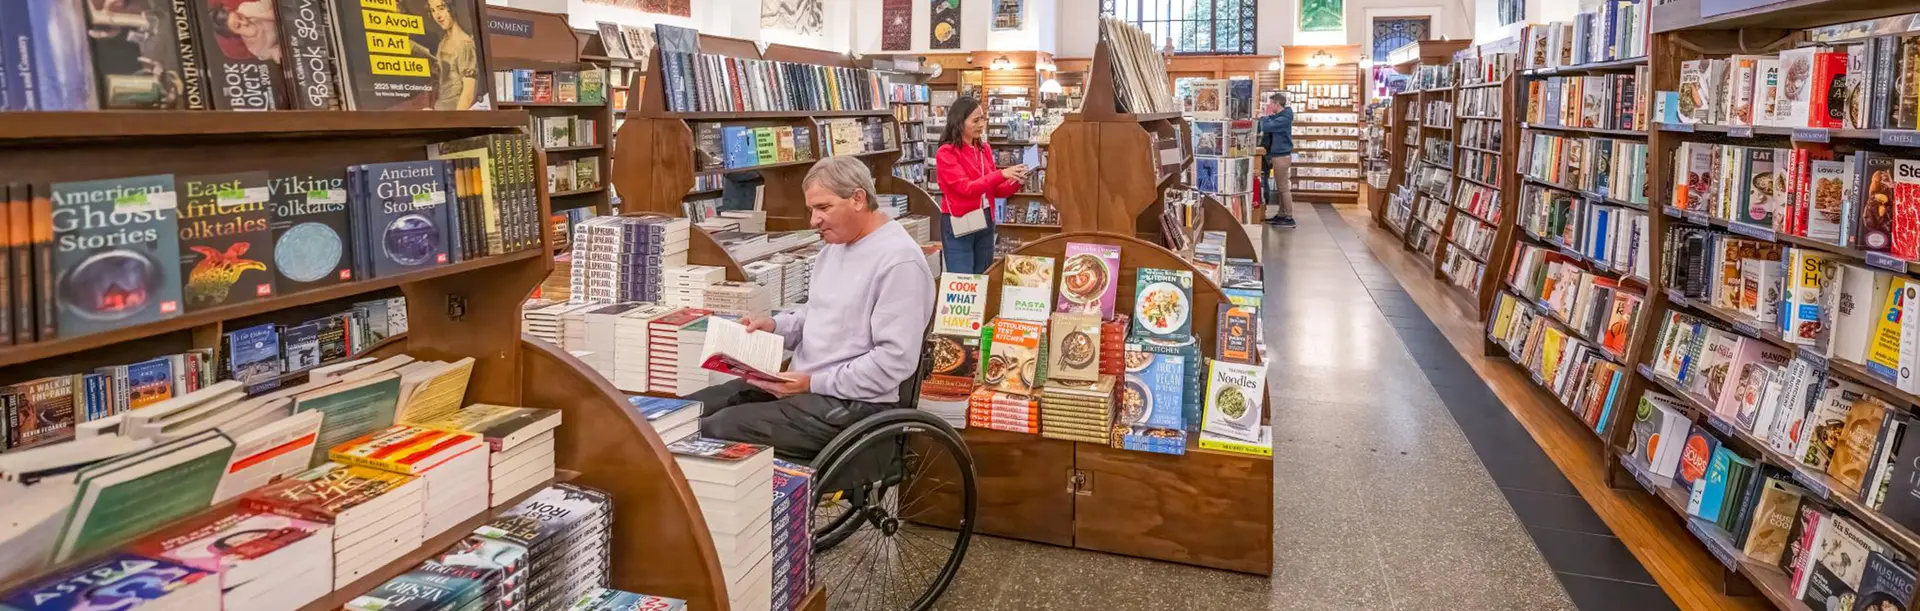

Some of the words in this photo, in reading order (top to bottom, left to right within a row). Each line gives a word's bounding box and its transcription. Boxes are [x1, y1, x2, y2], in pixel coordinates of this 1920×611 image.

[368, 13, 382, 25] to
[385, 15, 419, 29] Avoid
[372, 36, 384, 48] in
[387, 38, 405, 49] Art
[376, 61, 401, 72] and
[403, 62, 424, 73] Life
[181, 43, 202, 109] JONATHAN
[303, 46, 328, 107] Book
[223, 63, 242, 107] BOOK
[374, 82, 389, 90] 2025
[390, 83, 404, 91] Wall
[404, 84, 433, 92] Calendar
[1753, 151, 1770, 160] EAT
[379, 166, 434, 180] Ancient
[186, 179, 242, 198] East
[267, 176, 344, 196] Viking
[377, 179, 439, 199] Ghost
[51, 185, 164, 206] American
[384, 200, 436, 214] Stories
[52, 206, 167, 232] Ghost
[180, 216, 268, 240] olktales
[59, 227, 158, 253] Stories
[949, 281, 977, 292] COOK
[946, 293, 977, 304] WHAT
[1015, 300, 1045, 309] PASTA
[950, 304, 971, 316] YOU
[942, 315, 971, 328] HAVE
[997, 321, 1039, 333] OTTOLENGHI
[995, 333, 1025, 343] KITCHEN
[997, 327, 1014, 335] TEST
[1150, 345, 1180, 354] KITCHEN
[36, 379, 60, 394] WALK
[1155, 373, 1181, 386] VEGAN
[1217, 371, 1257, 389] Noodles
[49, 387, 72, 401] PARK
[1783, 375, 1797, 408] BUTCHERY
[1789, 378, 1803, 410] BUTCHERY
[22, 427, 41, 438] KEVIN
[1684, 446, 1707, 472] SOUPS
[523, 510, 553, 522] CAST
[526, 501, 570, 518] IRON
[1832, 518, 1845, 530] Six
[1843, 526, 1872, 551] Seasons
[33, 559, 159, 606] ASTRA
